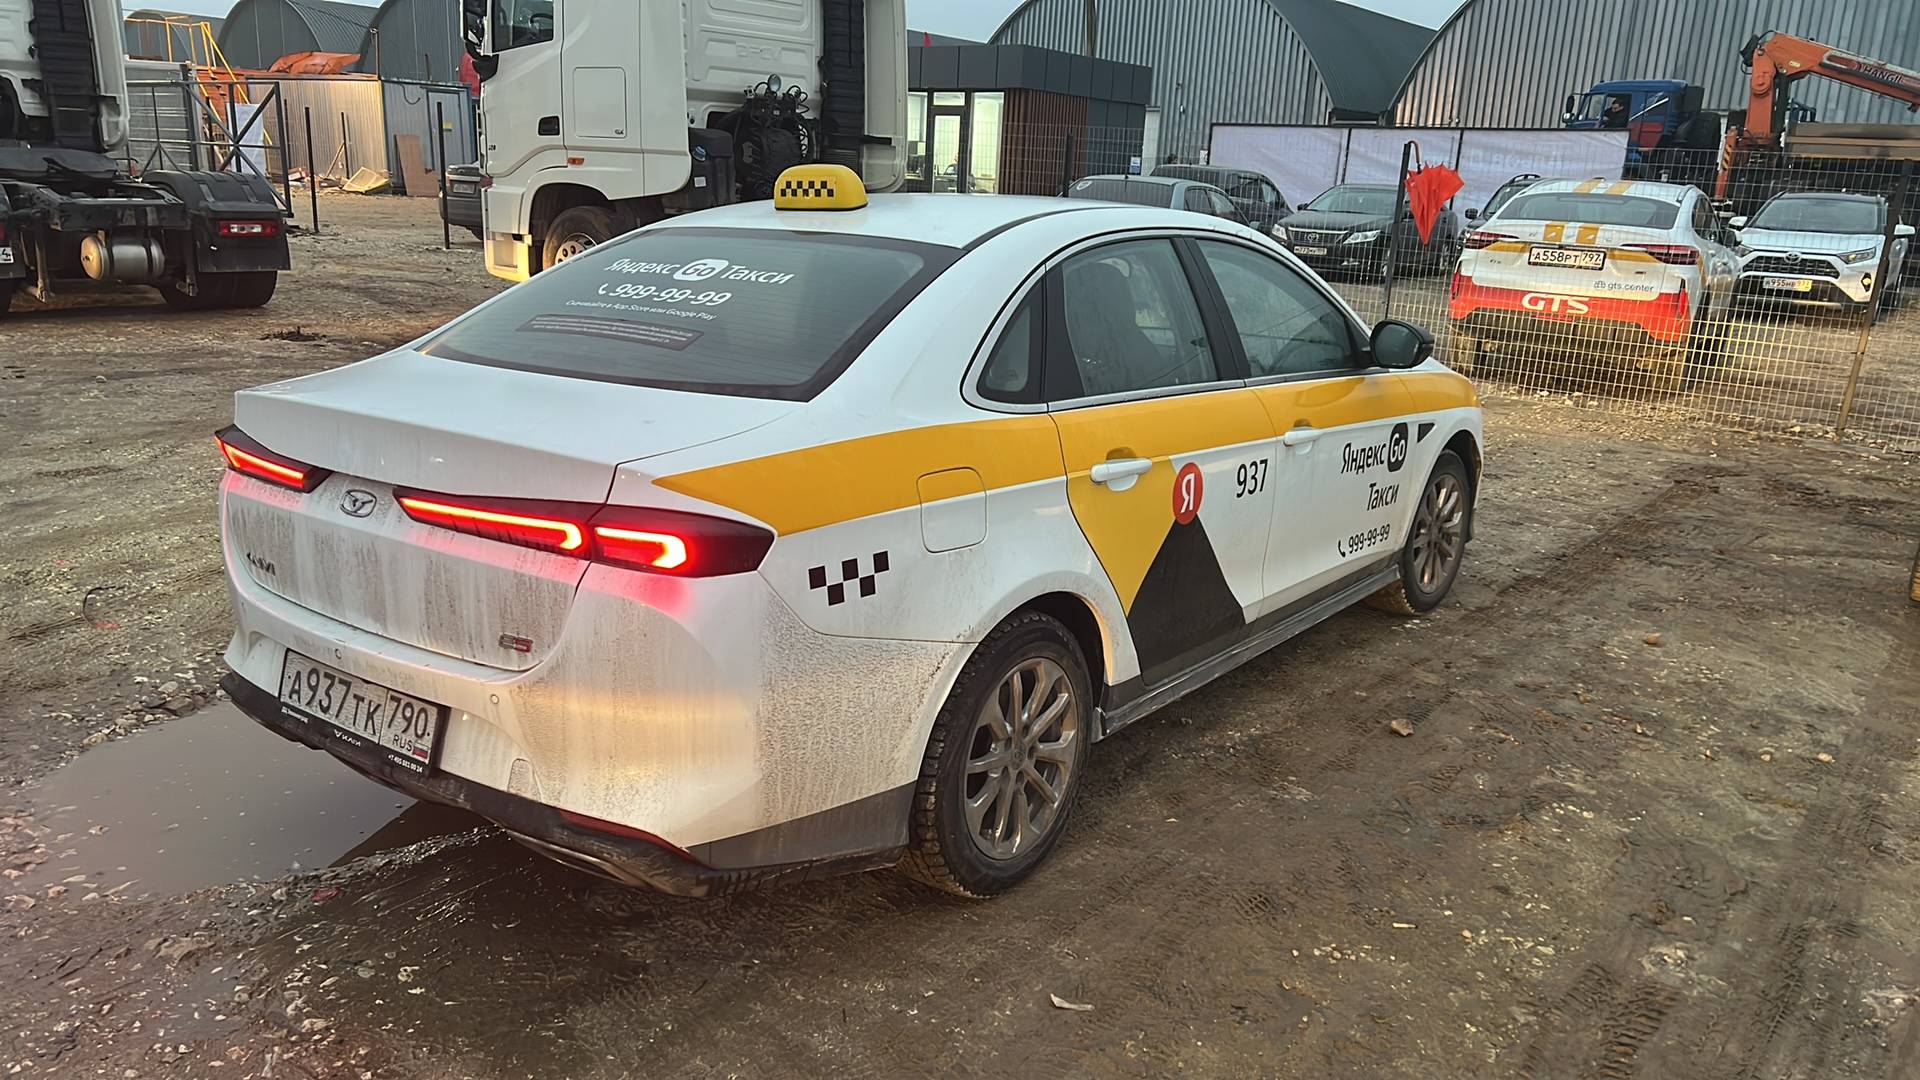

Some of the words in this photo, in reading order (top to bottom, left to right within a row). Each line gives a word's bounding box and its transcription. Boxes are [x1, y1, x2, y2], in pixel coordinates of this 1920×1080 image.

[1533, 250, 1580, 264] А558РТ
[1581, 251, 1602, 263] 797
[603, 258, 680, 276] Яндекс
[682, 261, 718, 278] Go
[720, 264, 795, 285] Такси
[609, 283, 732, 306] 999-99-99
[1520, 293, 1590, 315] GTS
[666, 307, 697, 319] Google
[696, 312, 717, 322] Play
[1341, 442, 1386, 475] Яндекс
[1388, 430, 1407, 464] Go
[1235, 458, 1268, 498] 937
[1180, 473, 1195, 513] Я
[1366, 482, 1399, 511] Такси
[1348, 523, 1391, 554] 999-99-99
[288, 668, 383, 736] А937ТК
[388, 694, 428, 739] 790
[393, 734, 414, 751] RUS
